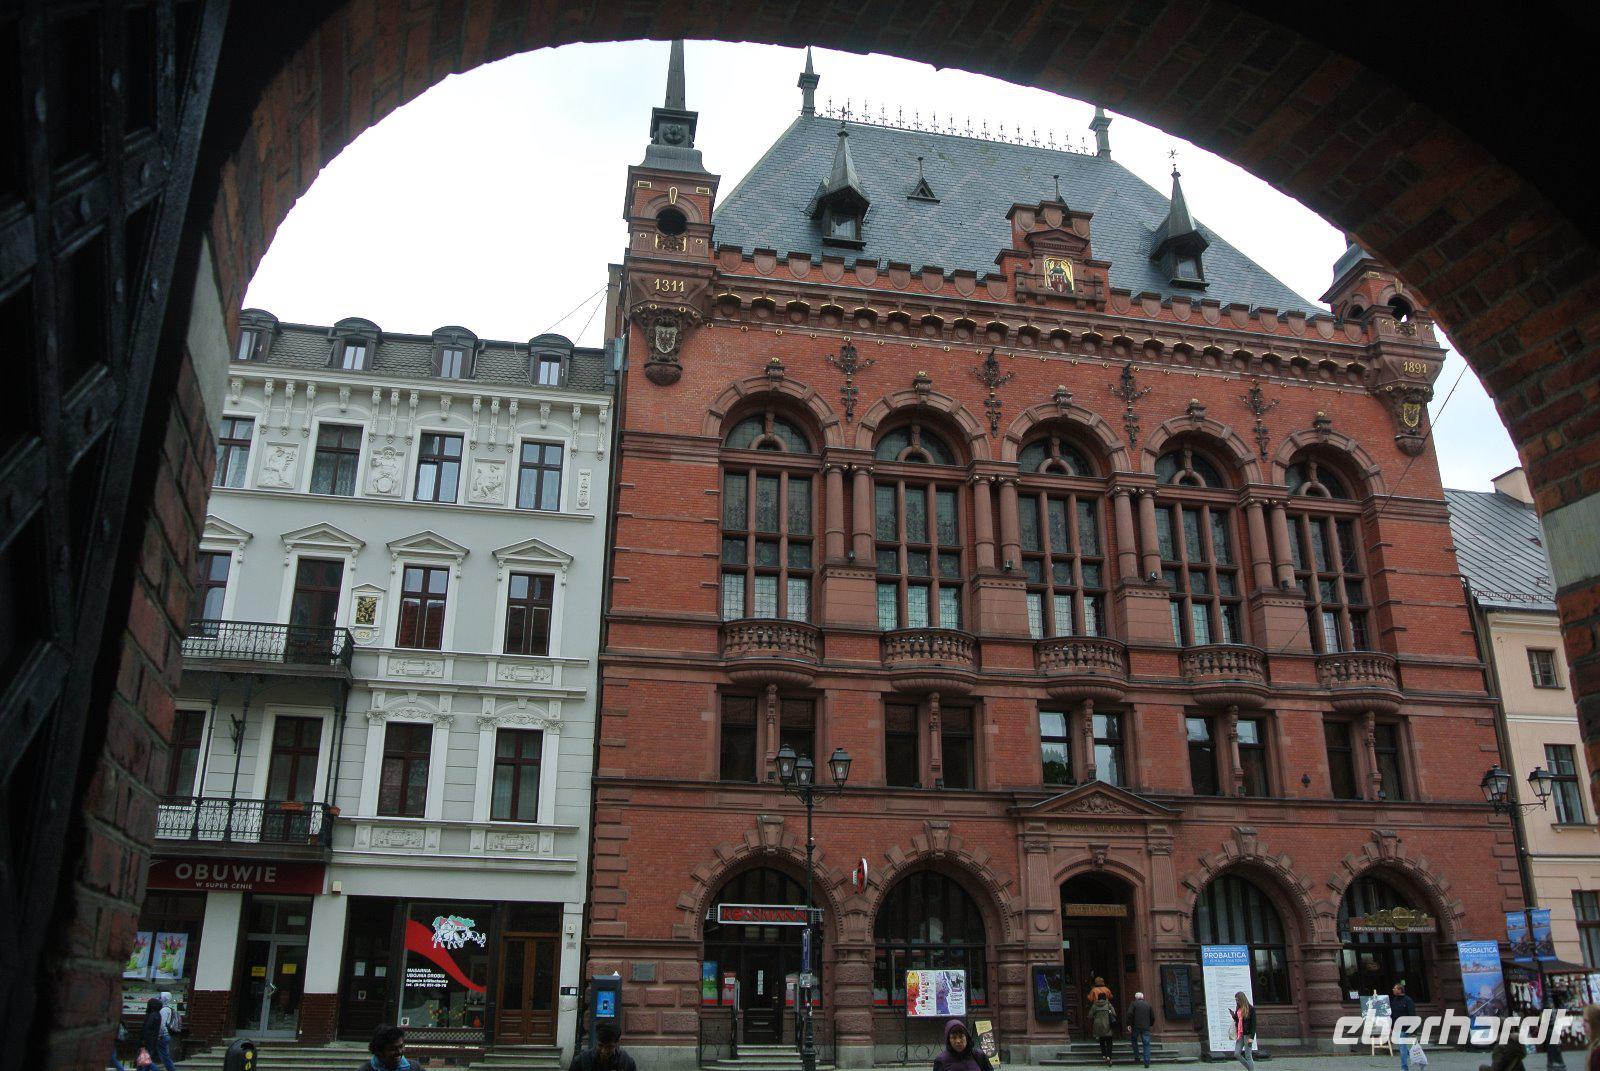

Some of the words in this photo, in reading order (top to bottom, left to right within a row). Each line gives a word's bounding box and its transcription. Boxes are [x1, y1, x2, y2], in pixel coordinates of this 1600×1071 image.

[654, 278, 685, 292] 1311
[1403, 361, 1427, 374] 1891
[175, 863, 277, 883] OBUWIE
[1459, 946, 1498, 954] PROBALTICA
